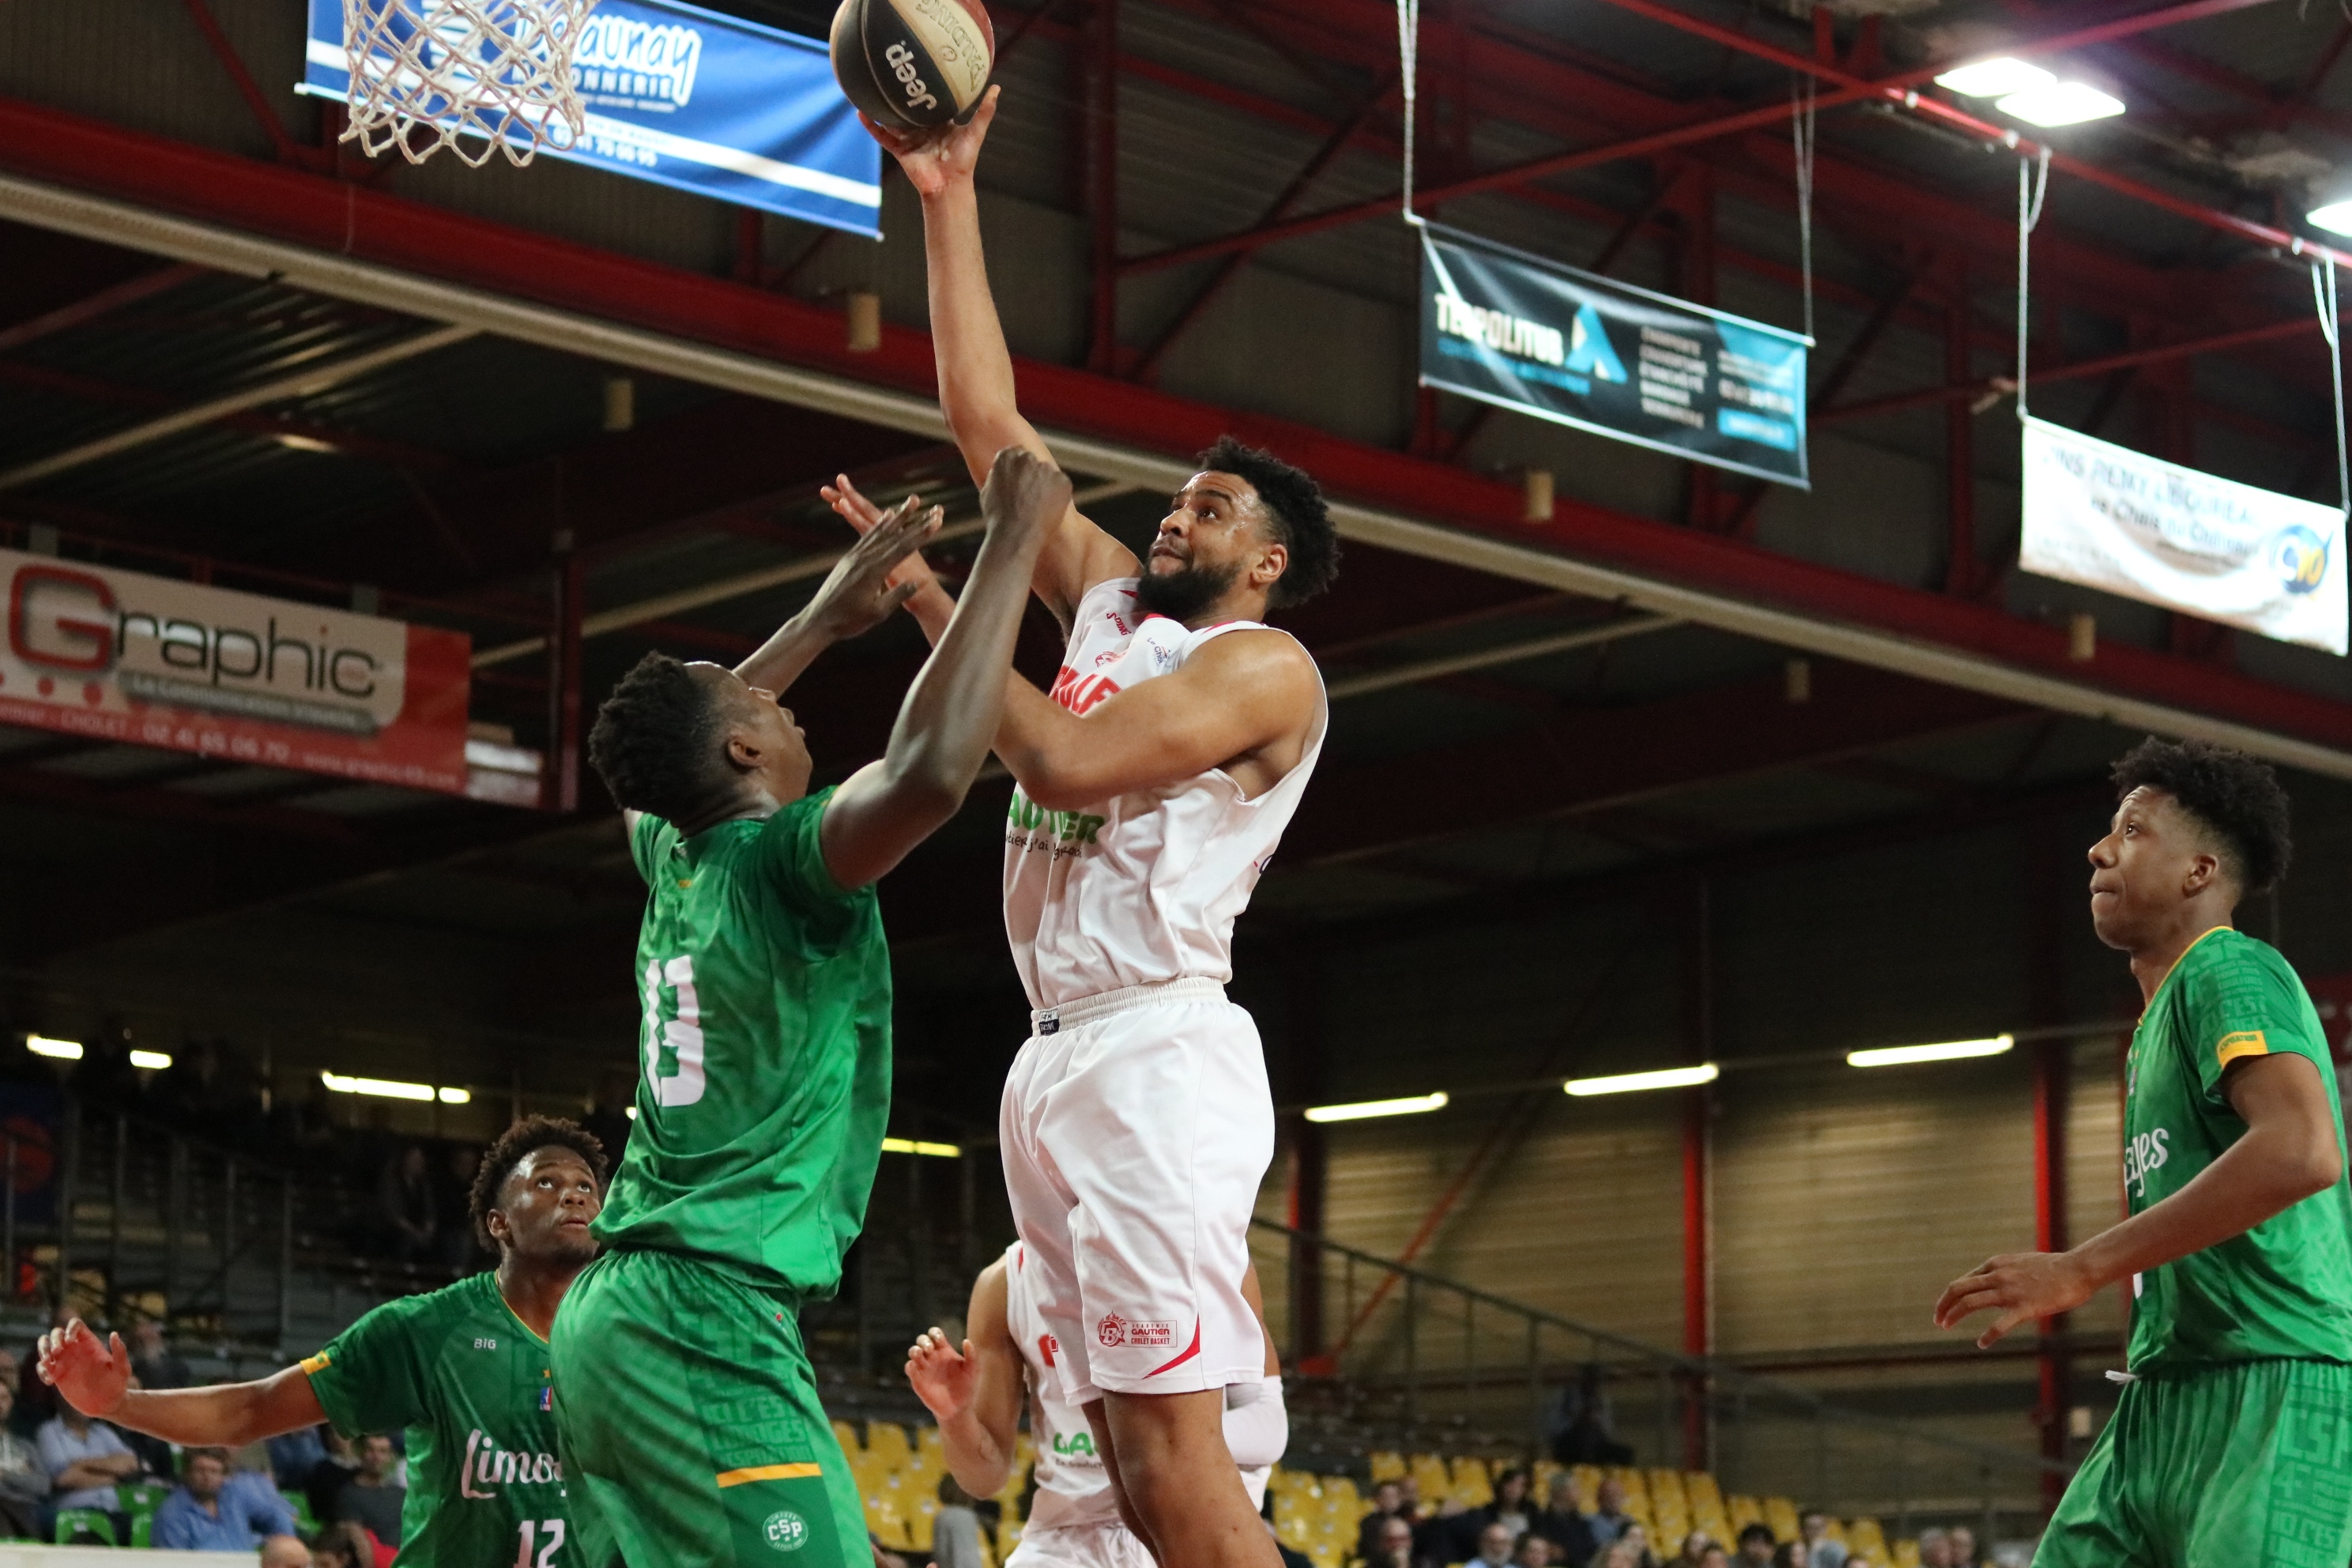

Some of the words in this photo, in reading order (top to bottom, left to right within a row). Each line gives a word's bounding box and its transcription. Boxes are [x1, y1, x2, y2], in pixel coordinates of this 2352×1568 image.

[885, 43, 937, 110] Jeep
[9, 564, 377, 697] Graphic
[645, 955, 706, 1106] 13
[514, 1518, 565, 1568] 12
[768, 1519, 803, 1540] CSP
